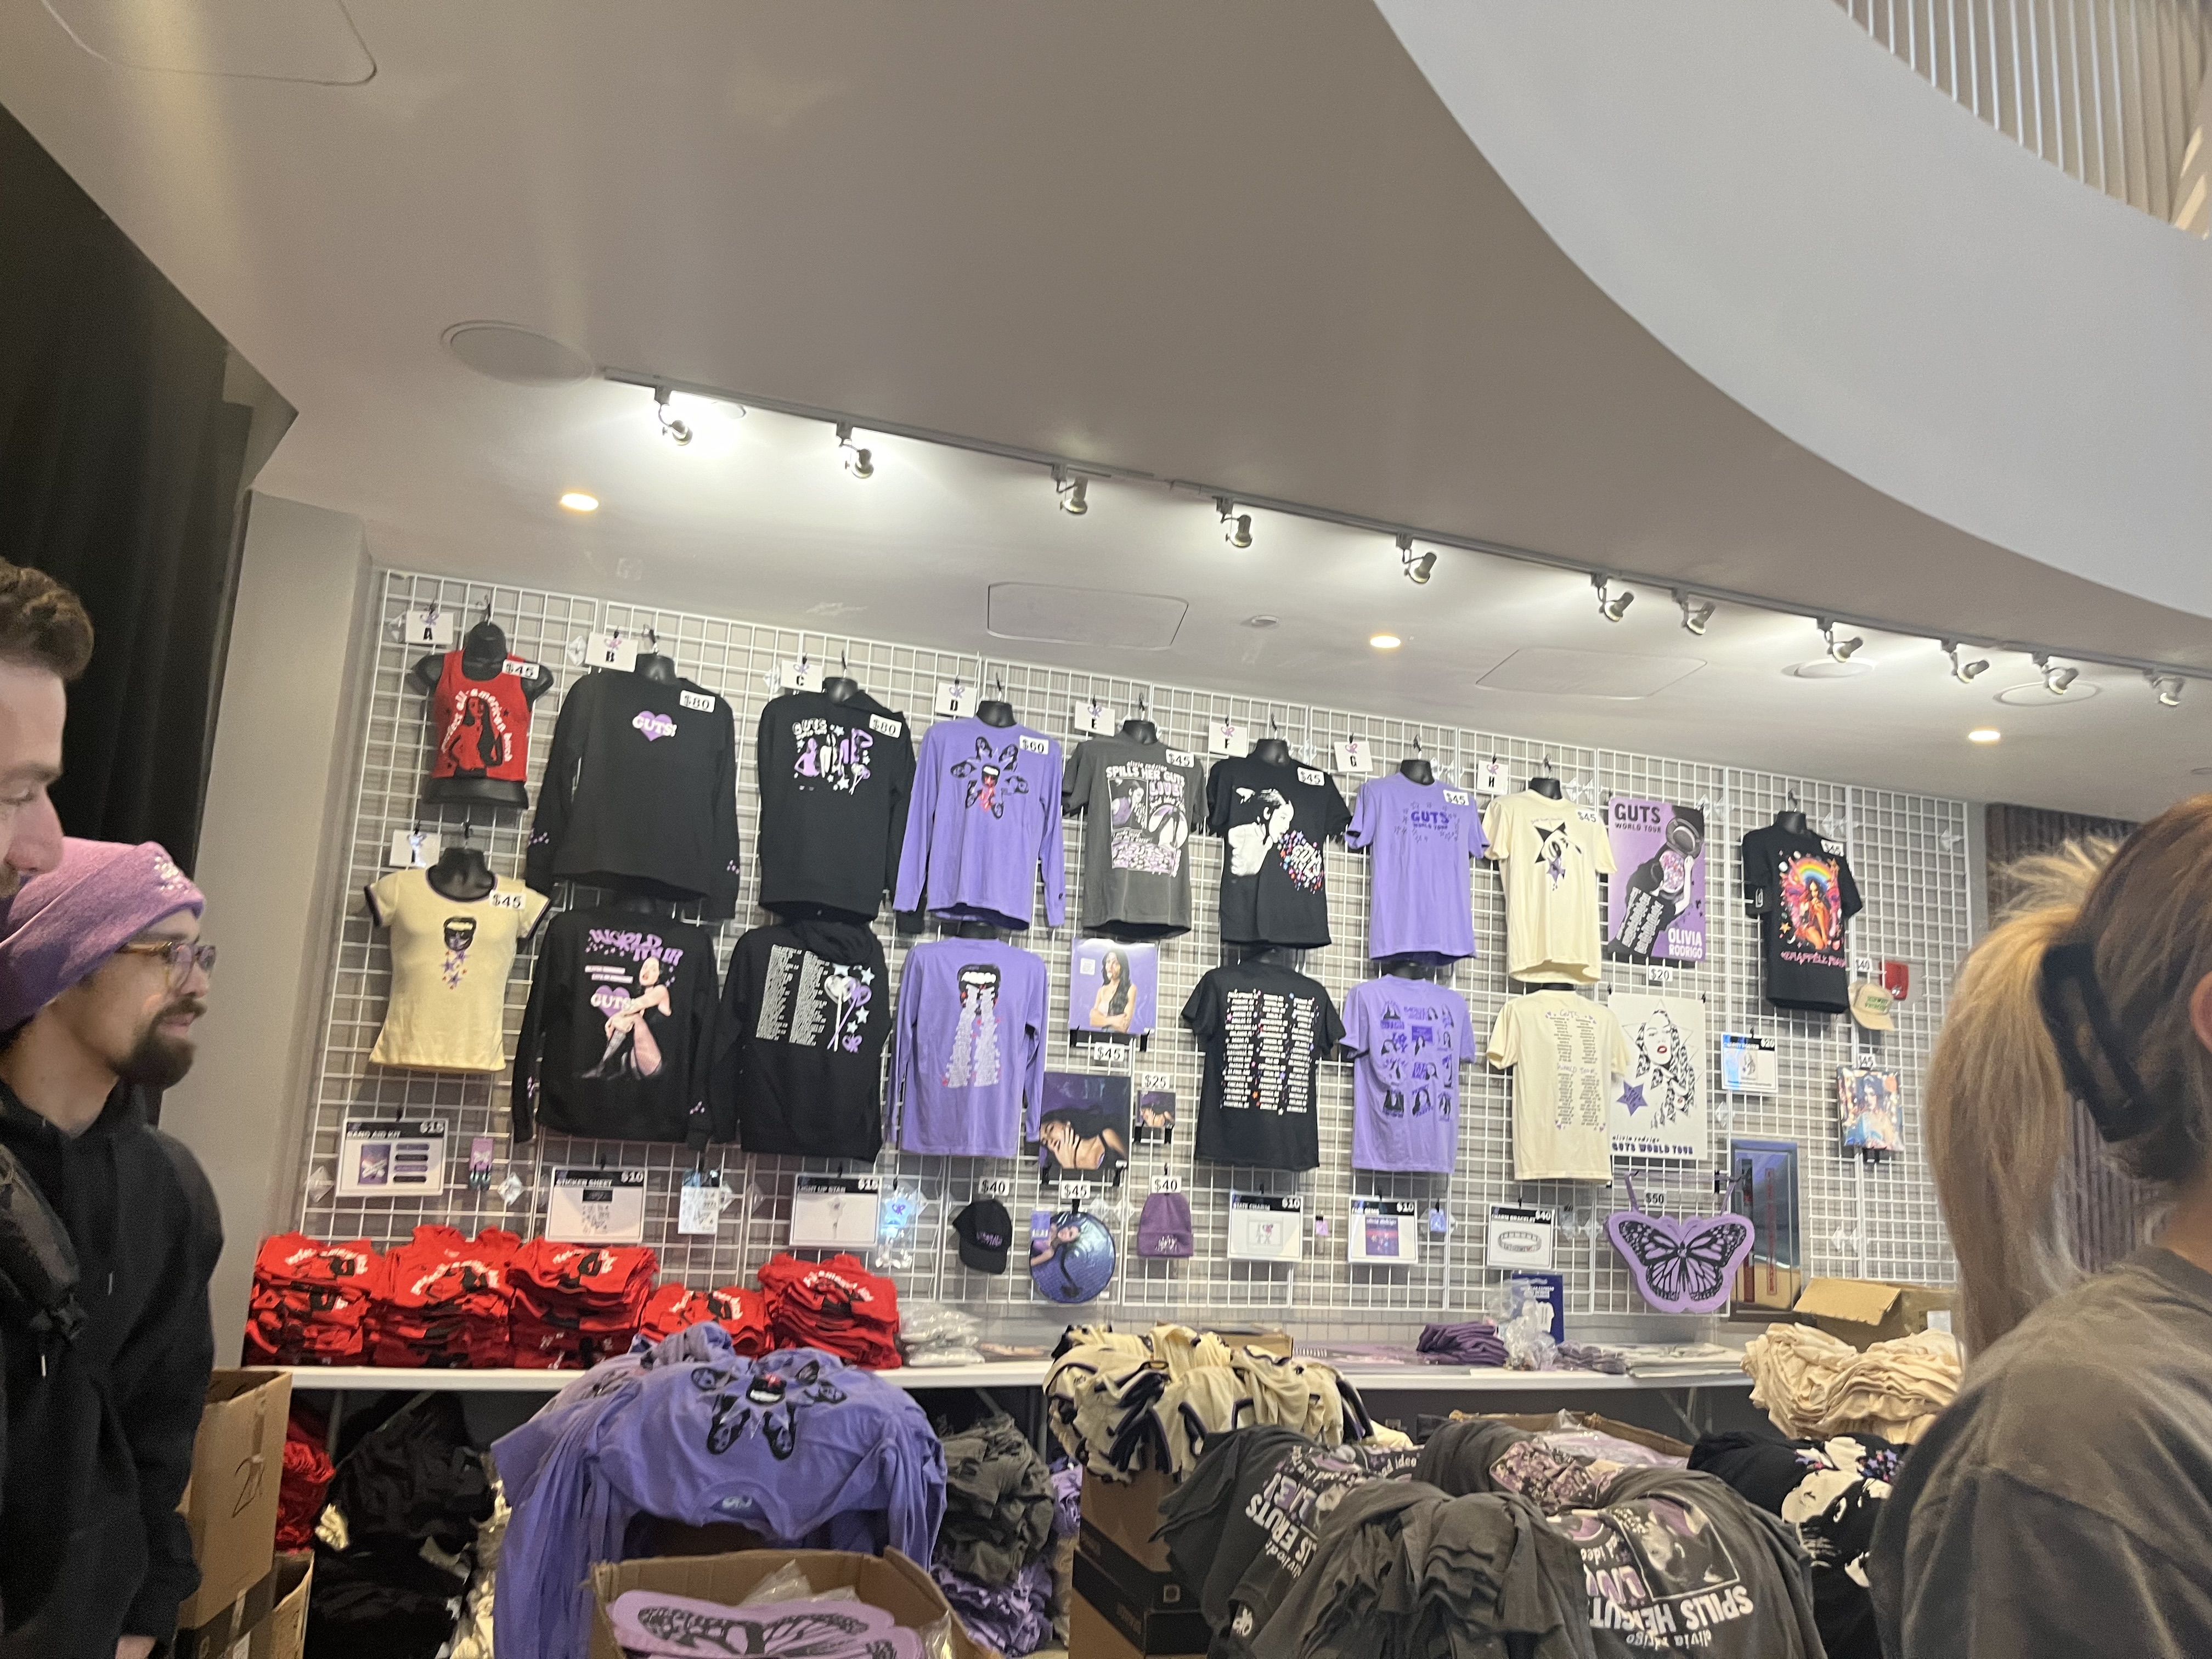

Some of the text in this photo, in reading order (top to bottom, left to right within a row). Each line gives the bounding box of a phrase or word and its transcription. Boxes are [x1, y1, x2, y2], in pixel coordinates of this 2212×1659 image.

[506, 662, 534, 678] $45
[684, 695, 709, 710] $80
[632, 715, 678, 737] GUTS!
[1169, 753, 1190, 766] $45
[1105, 765, 1186, 787] SPILLS HER GUTS
[1300, 771, 1321, 785] $45
[1447, 793, 1465, 805] $45
[1411, 811, 1449, 823] GUTS
[1578, 811, 1596, 822] $45
[1615, 803, 1661, 823] GUTS
[1615, 823, 1641, 831] WORLD
[493, 894, 522, 908] $45
[1668, 928, 1702, 946] OLIVIA
[1669, 944, 1702, 959] RODRIGO
[1651, 968, 1669, 980] $20
[1098, 1046, 1120, 1060] $45
[1145, 1074, 1166, 1088] $25
[1612, 1142, 1692, 1154] GUTS WORLD TOUR
[982, 1180, 1005, 1194] $40
[1065, 1184, 1087, 1198] $45
[1154, 1180, 1177, 1192] $40
[1646, 1193, 1664, 1204] $50
[1397, 1201, 1414, 1212] $10
[1536, 1210, 1551, 1220] $40
